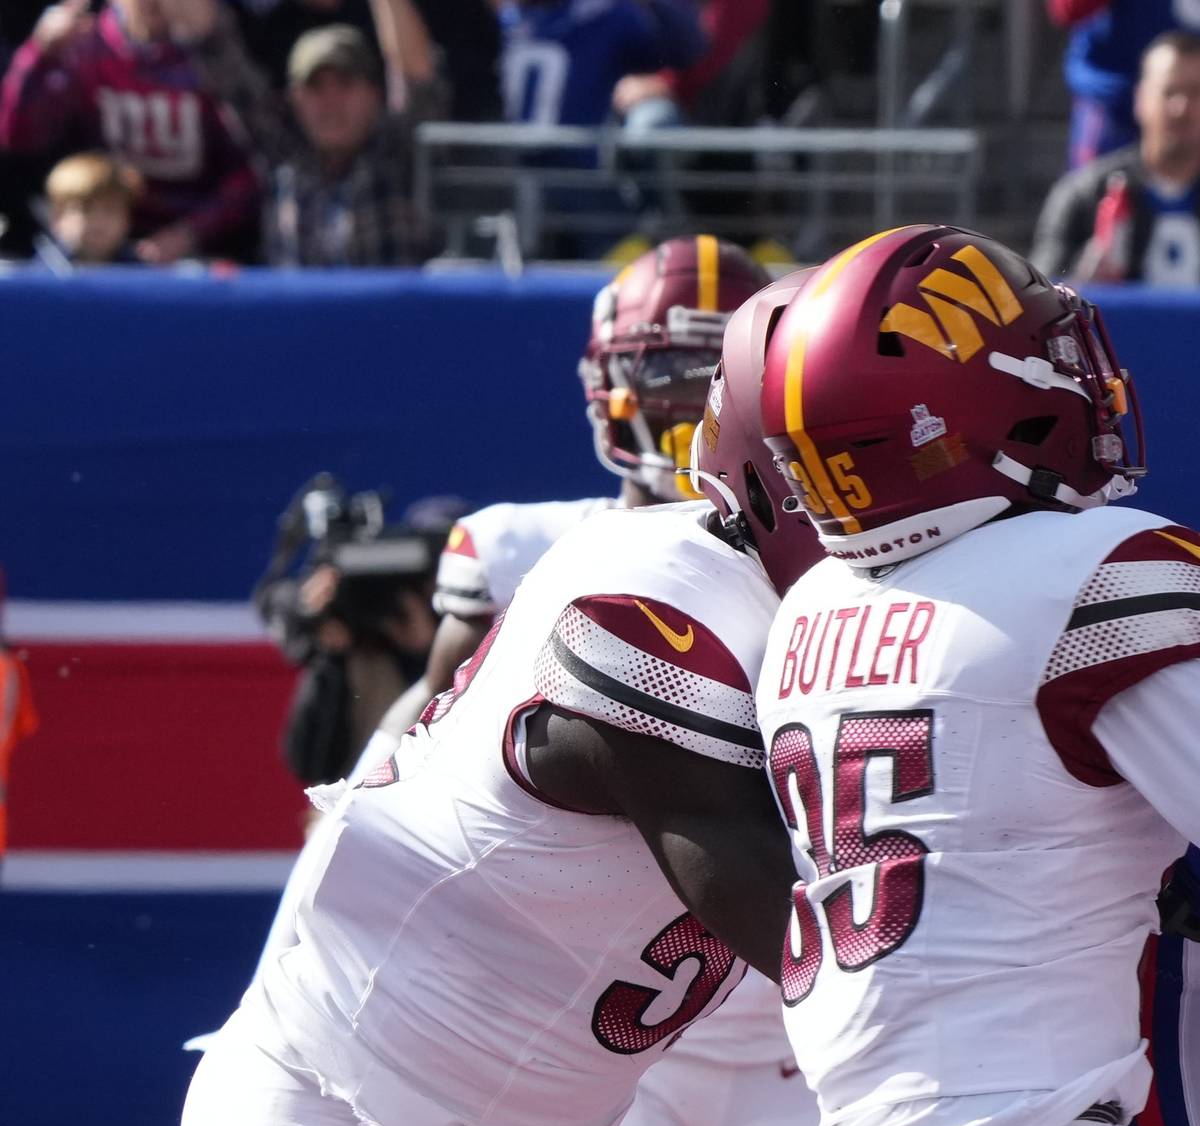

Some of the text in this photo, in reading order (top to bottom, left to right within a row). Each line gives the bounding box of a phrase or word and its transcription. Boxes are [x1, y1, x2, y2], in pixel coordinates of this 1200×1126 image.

[789, 452, 873, 515] 35
[834, 526, 942, 560] HINGTON
[778, 600, 936, 700] BUTLER
[769, 708, 936, 1008] 35
